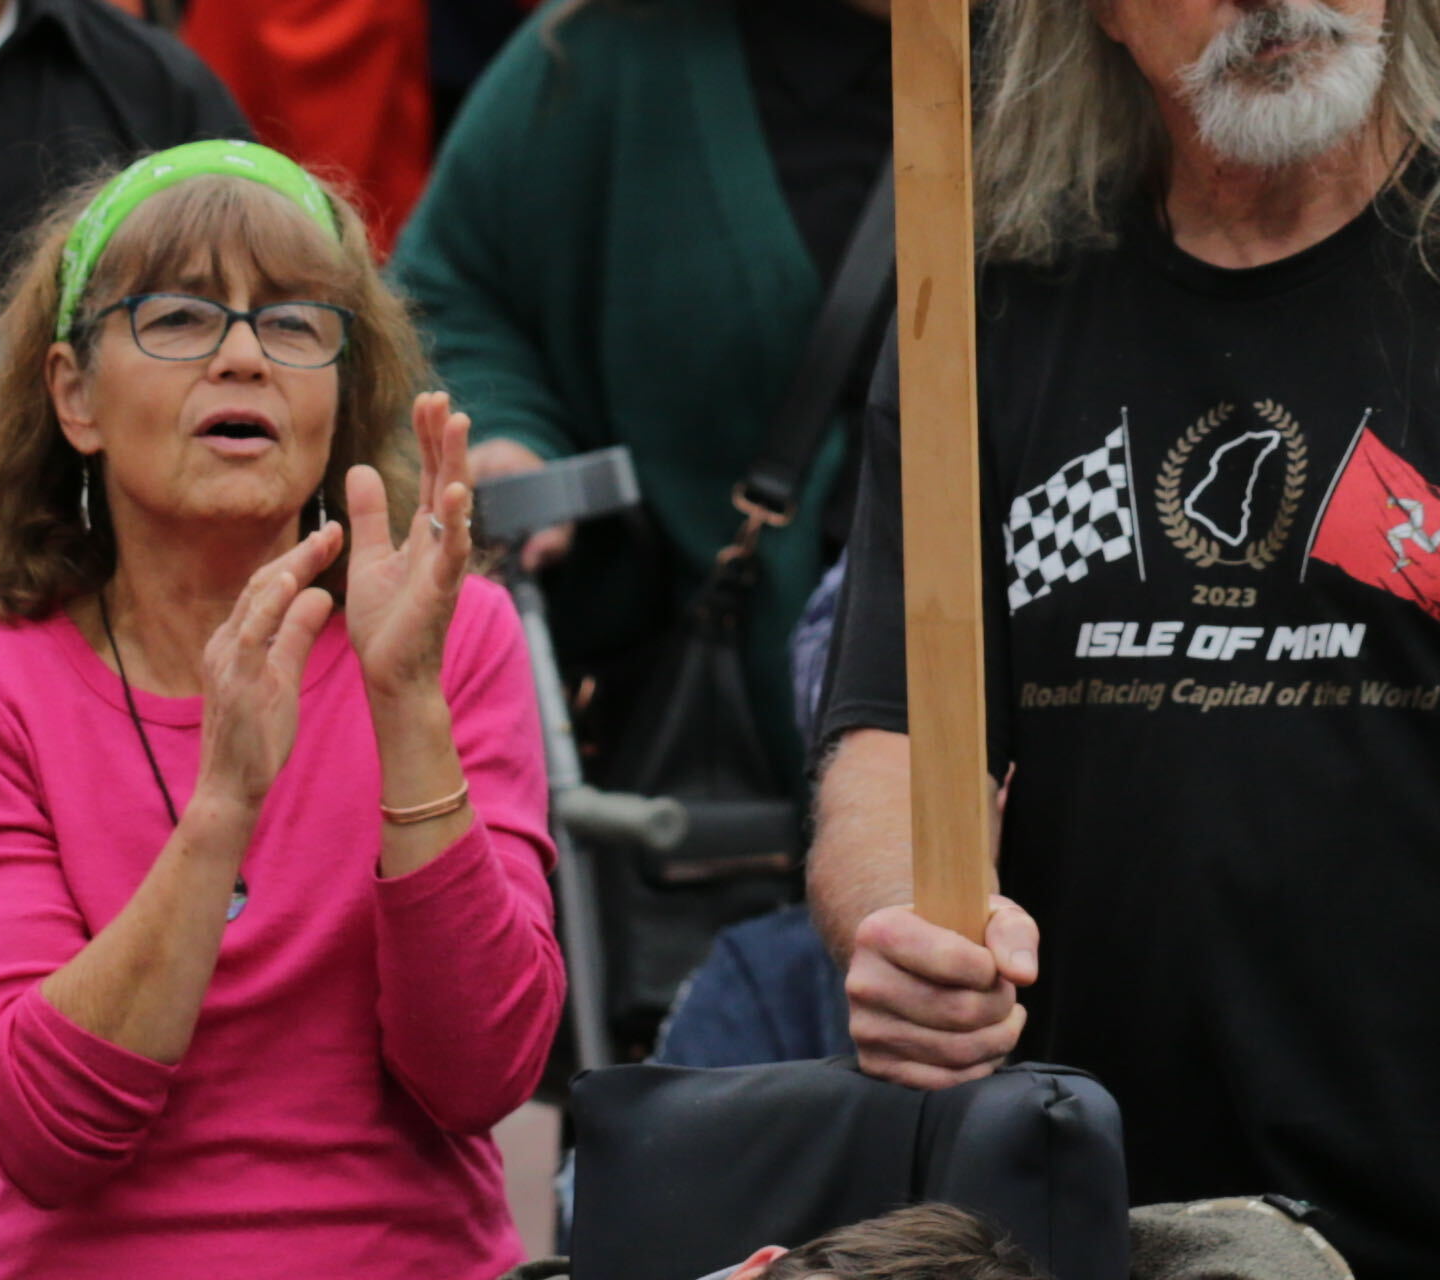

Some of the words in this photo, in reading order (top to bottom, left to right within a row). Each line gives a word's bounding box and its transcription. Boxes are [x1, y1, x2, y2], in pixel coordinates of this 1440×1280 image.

[1191, 584, 1258, 608] 2023
[1074, 621, 1185, 659] ISLE
[1185, 624, 1266, 661] OF
[1265, 622, 1367, 662] MAN
[1019, 679, 1084, 709] Road
[1086, 678, 1166, 711] Racing
[1171, 677, 1269, 714] Capital
[1276, 680, 1310, 708] of
[1312, 681, 1351, 708] the
